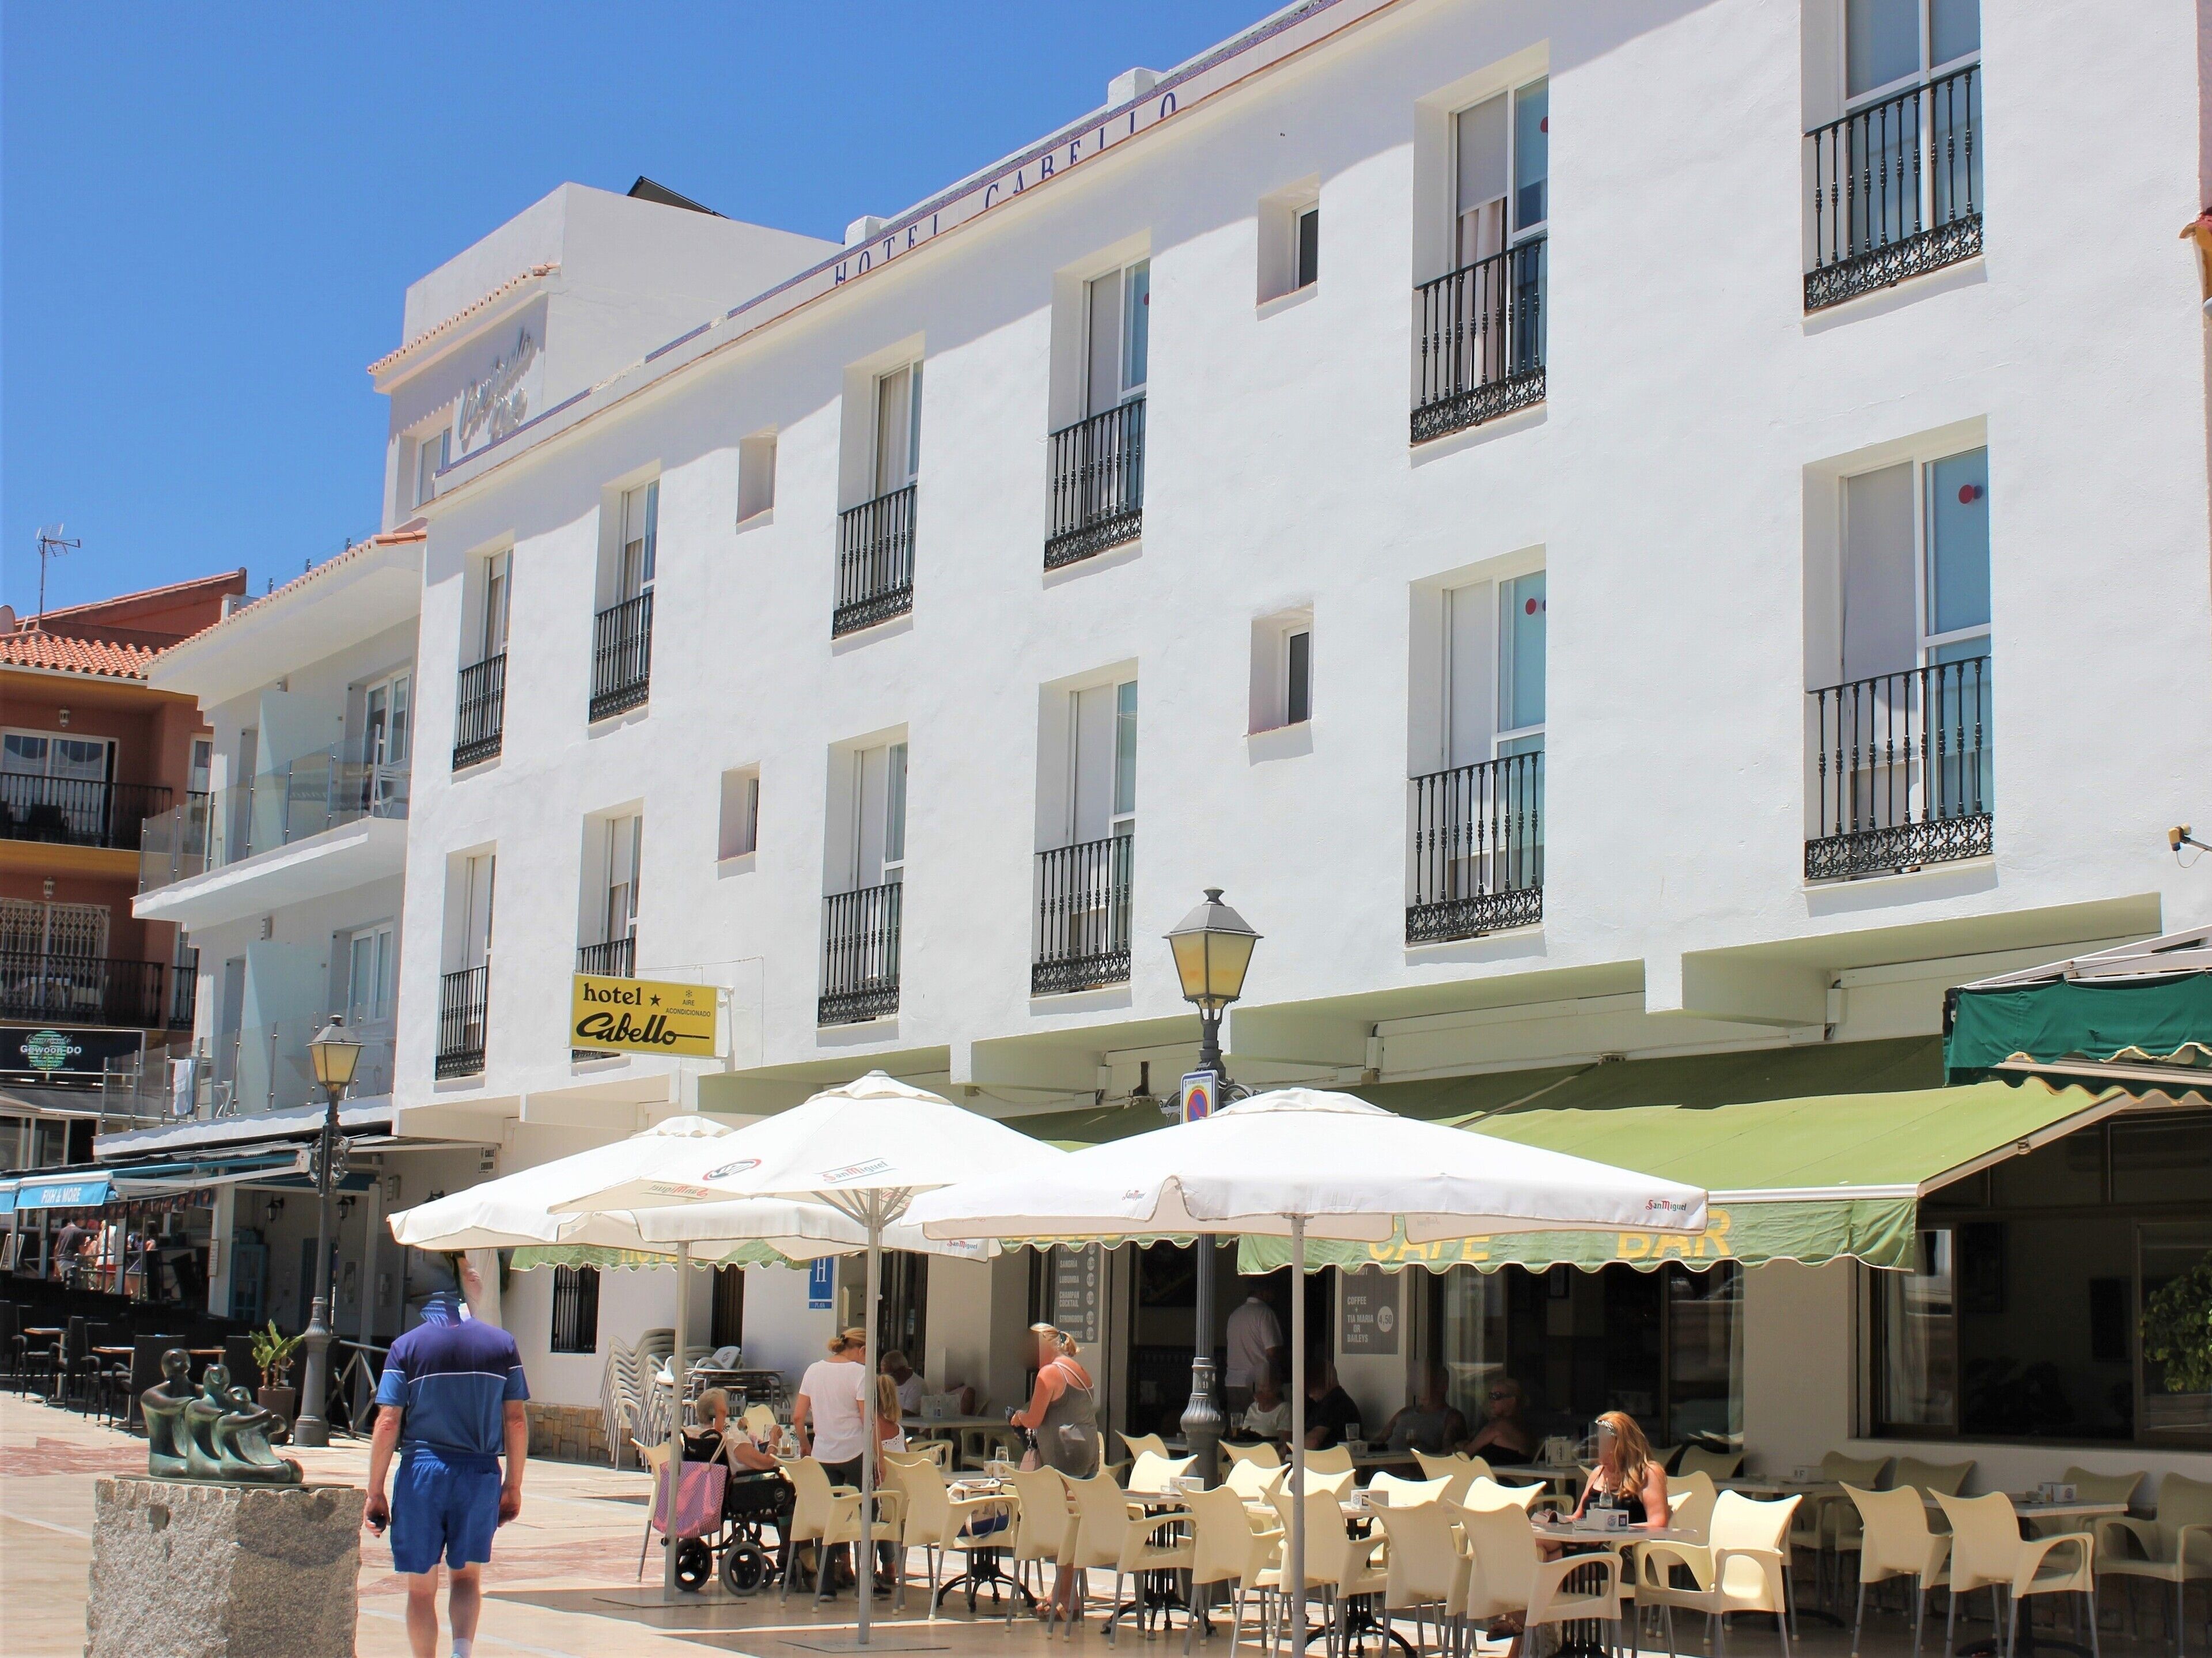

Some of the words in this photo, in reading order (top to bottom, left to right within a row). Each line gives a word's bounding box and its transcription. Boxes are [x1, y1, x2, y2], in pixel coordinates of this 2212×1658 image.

[583, 982, 642, 1006] hotel
[665, 1007, 711, 1017] ACONDICIONADO
[576, 1012, 710, 1046] Cabello
[20, 1045, 63, 1054] Gewoon
[66, 1046, 82, 1054] DO
[40, 1188, 56, 1203] FISH
[56, 1188, 62, 1203] &
[63, 1187, 82, 1203] MORE
[1616, 1210, 1732, 1259] BAR
[815, 1258, 827, 1282] H
[1347, 1296, 1367, 1305] COFFEE
[1347, 1315, 1355, 1323] TIA
[1357, 1314, 1374, 1323] MARIA
[1378, 1315, 1392, 1325] 4,50
[1353, 1324, 1361, 1333] OR
[1347, 1334, 1369, 1343] BAILEYS
